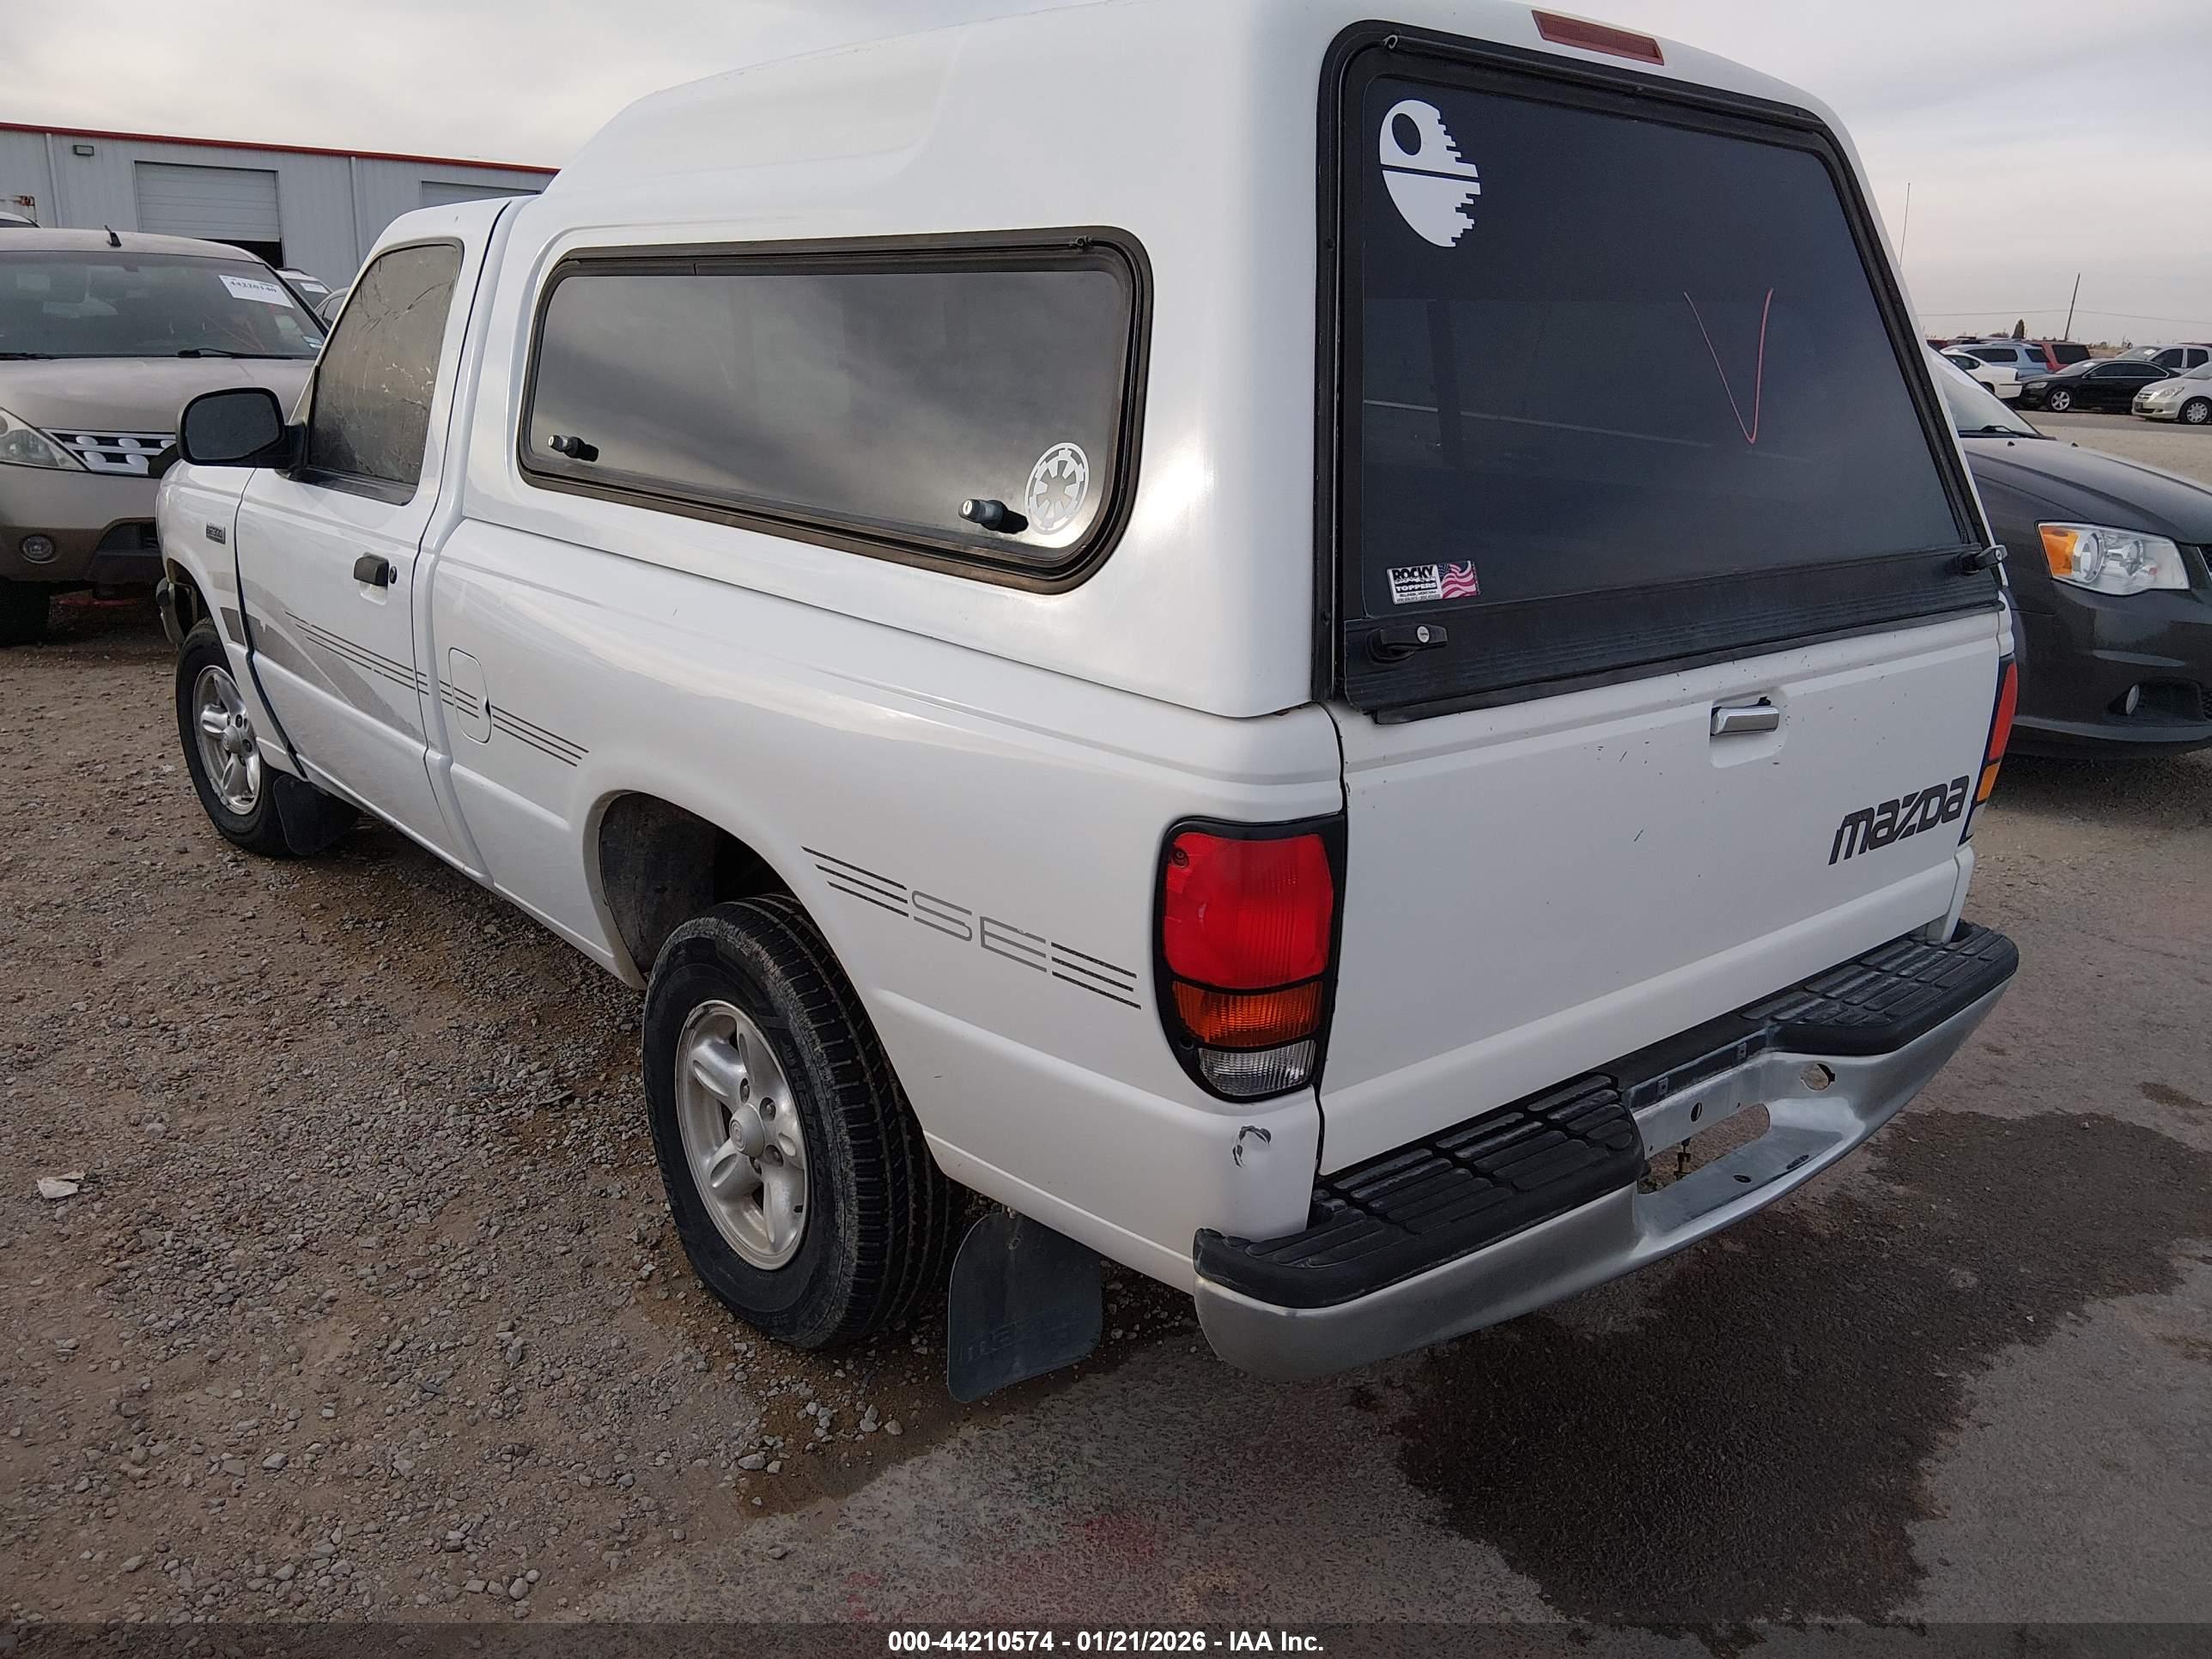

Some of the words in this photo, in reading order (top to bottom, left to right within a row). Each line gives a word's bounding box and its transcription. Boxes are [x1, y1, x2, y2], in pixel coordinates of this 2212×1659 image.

[1392, 566, 1433, 580] ROCKY
[1395, 582, 1437, 592] TOPPERS
[911, 890, 1048, 973] SE
